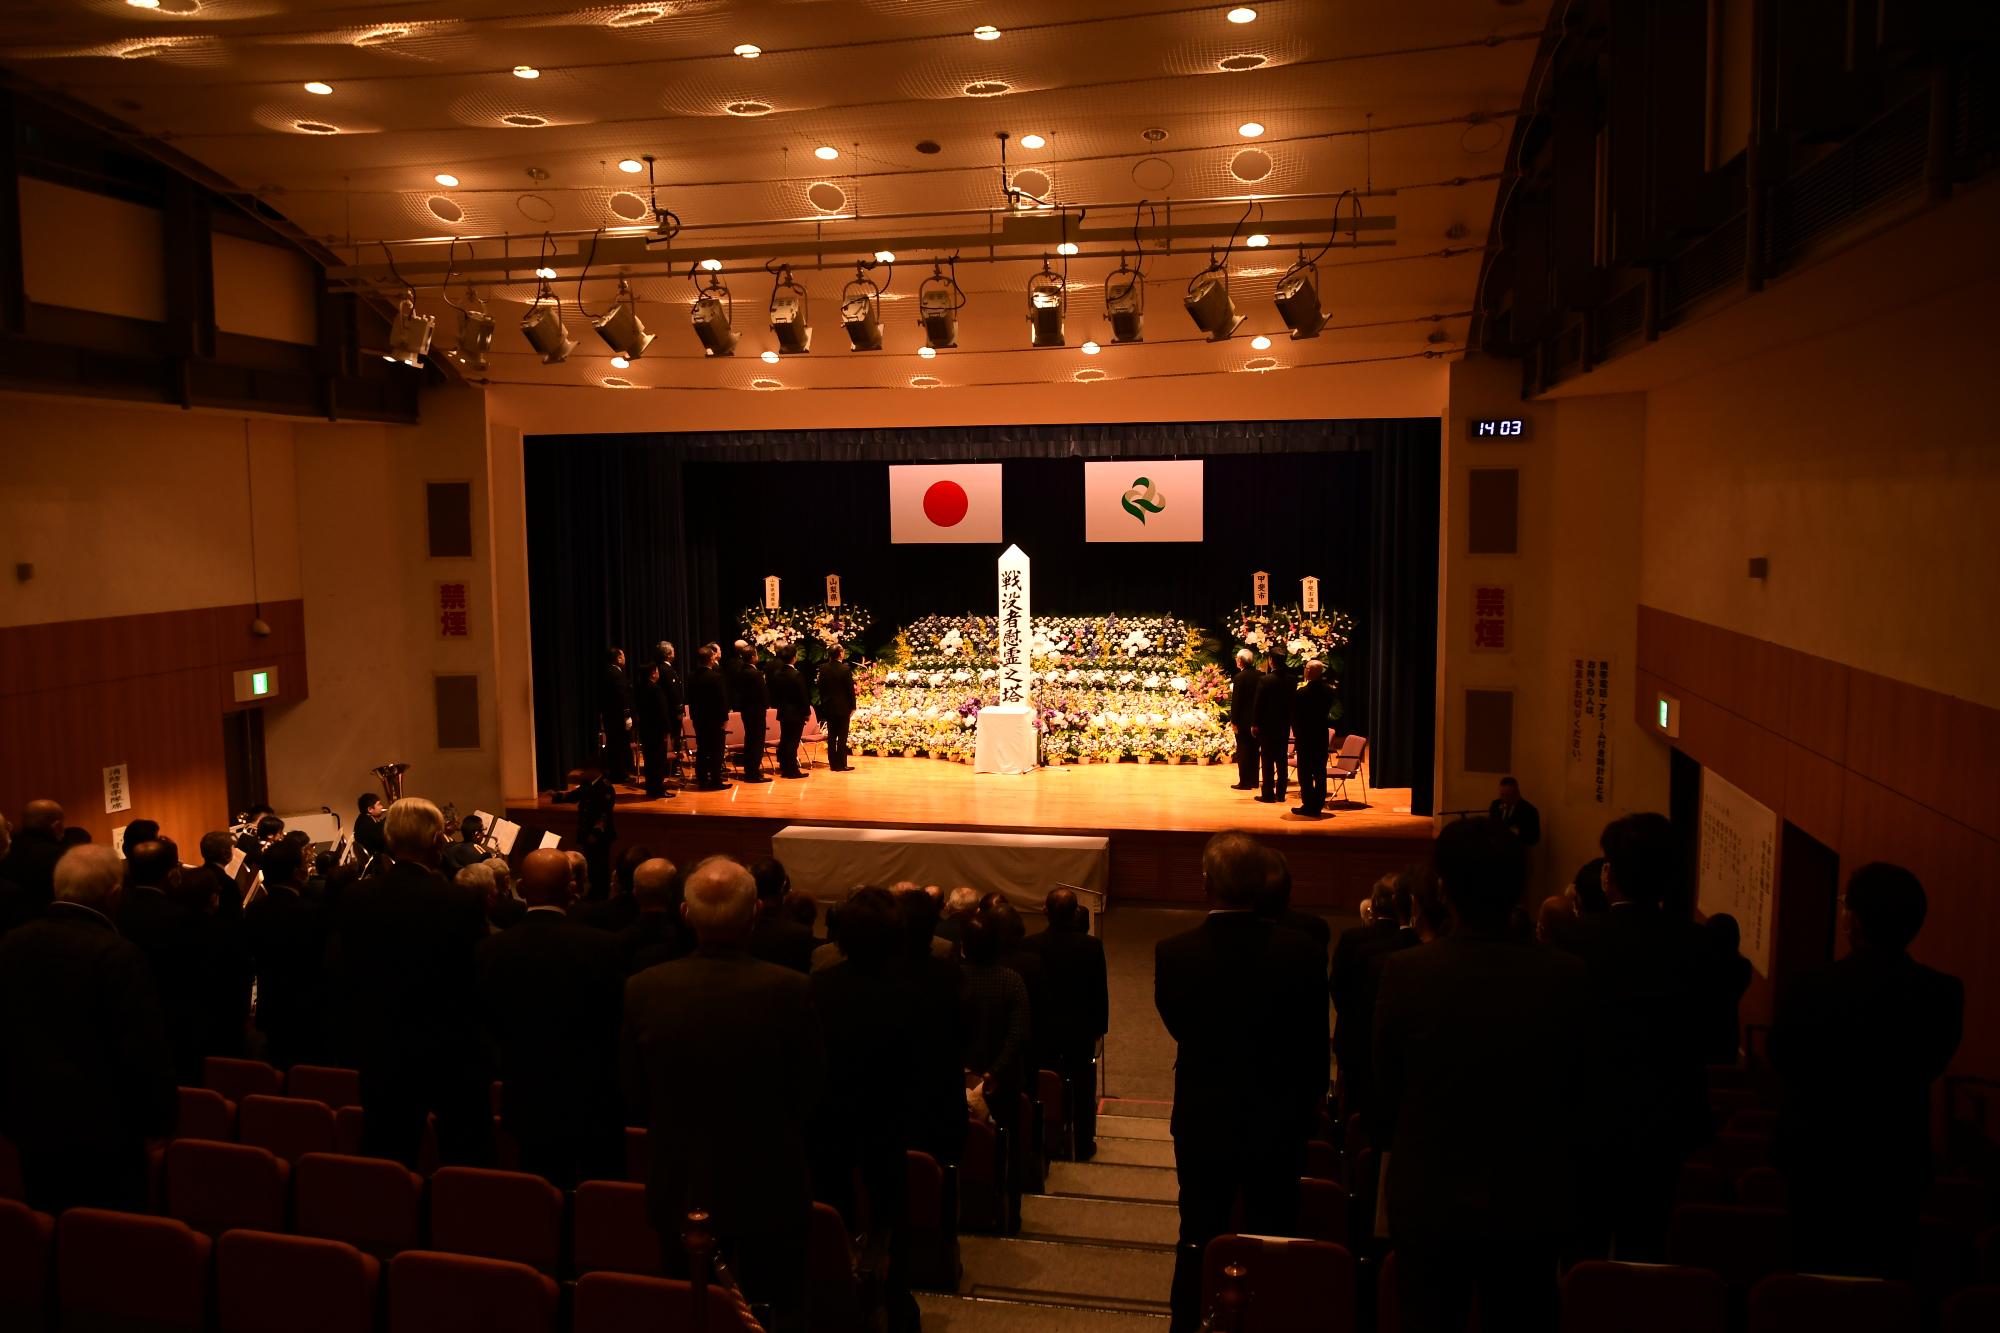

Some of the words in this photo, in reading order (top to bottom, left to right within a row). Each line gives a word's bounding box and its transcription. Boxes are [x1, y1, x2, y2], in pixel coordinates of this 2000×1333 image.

[1480, 422, 1494, 435] 14
[1500, 421, 1521, 435] 03
[829, 578, 838, 602] 山梨県
[1257, 576, 1266, 600] 甲斐市
[440, 584, 467, 636] 禁煙
[1475, 588, 1504, 648] 禁煙
[1001, 570, 1024, 703] 戦没者慰霊之塔
